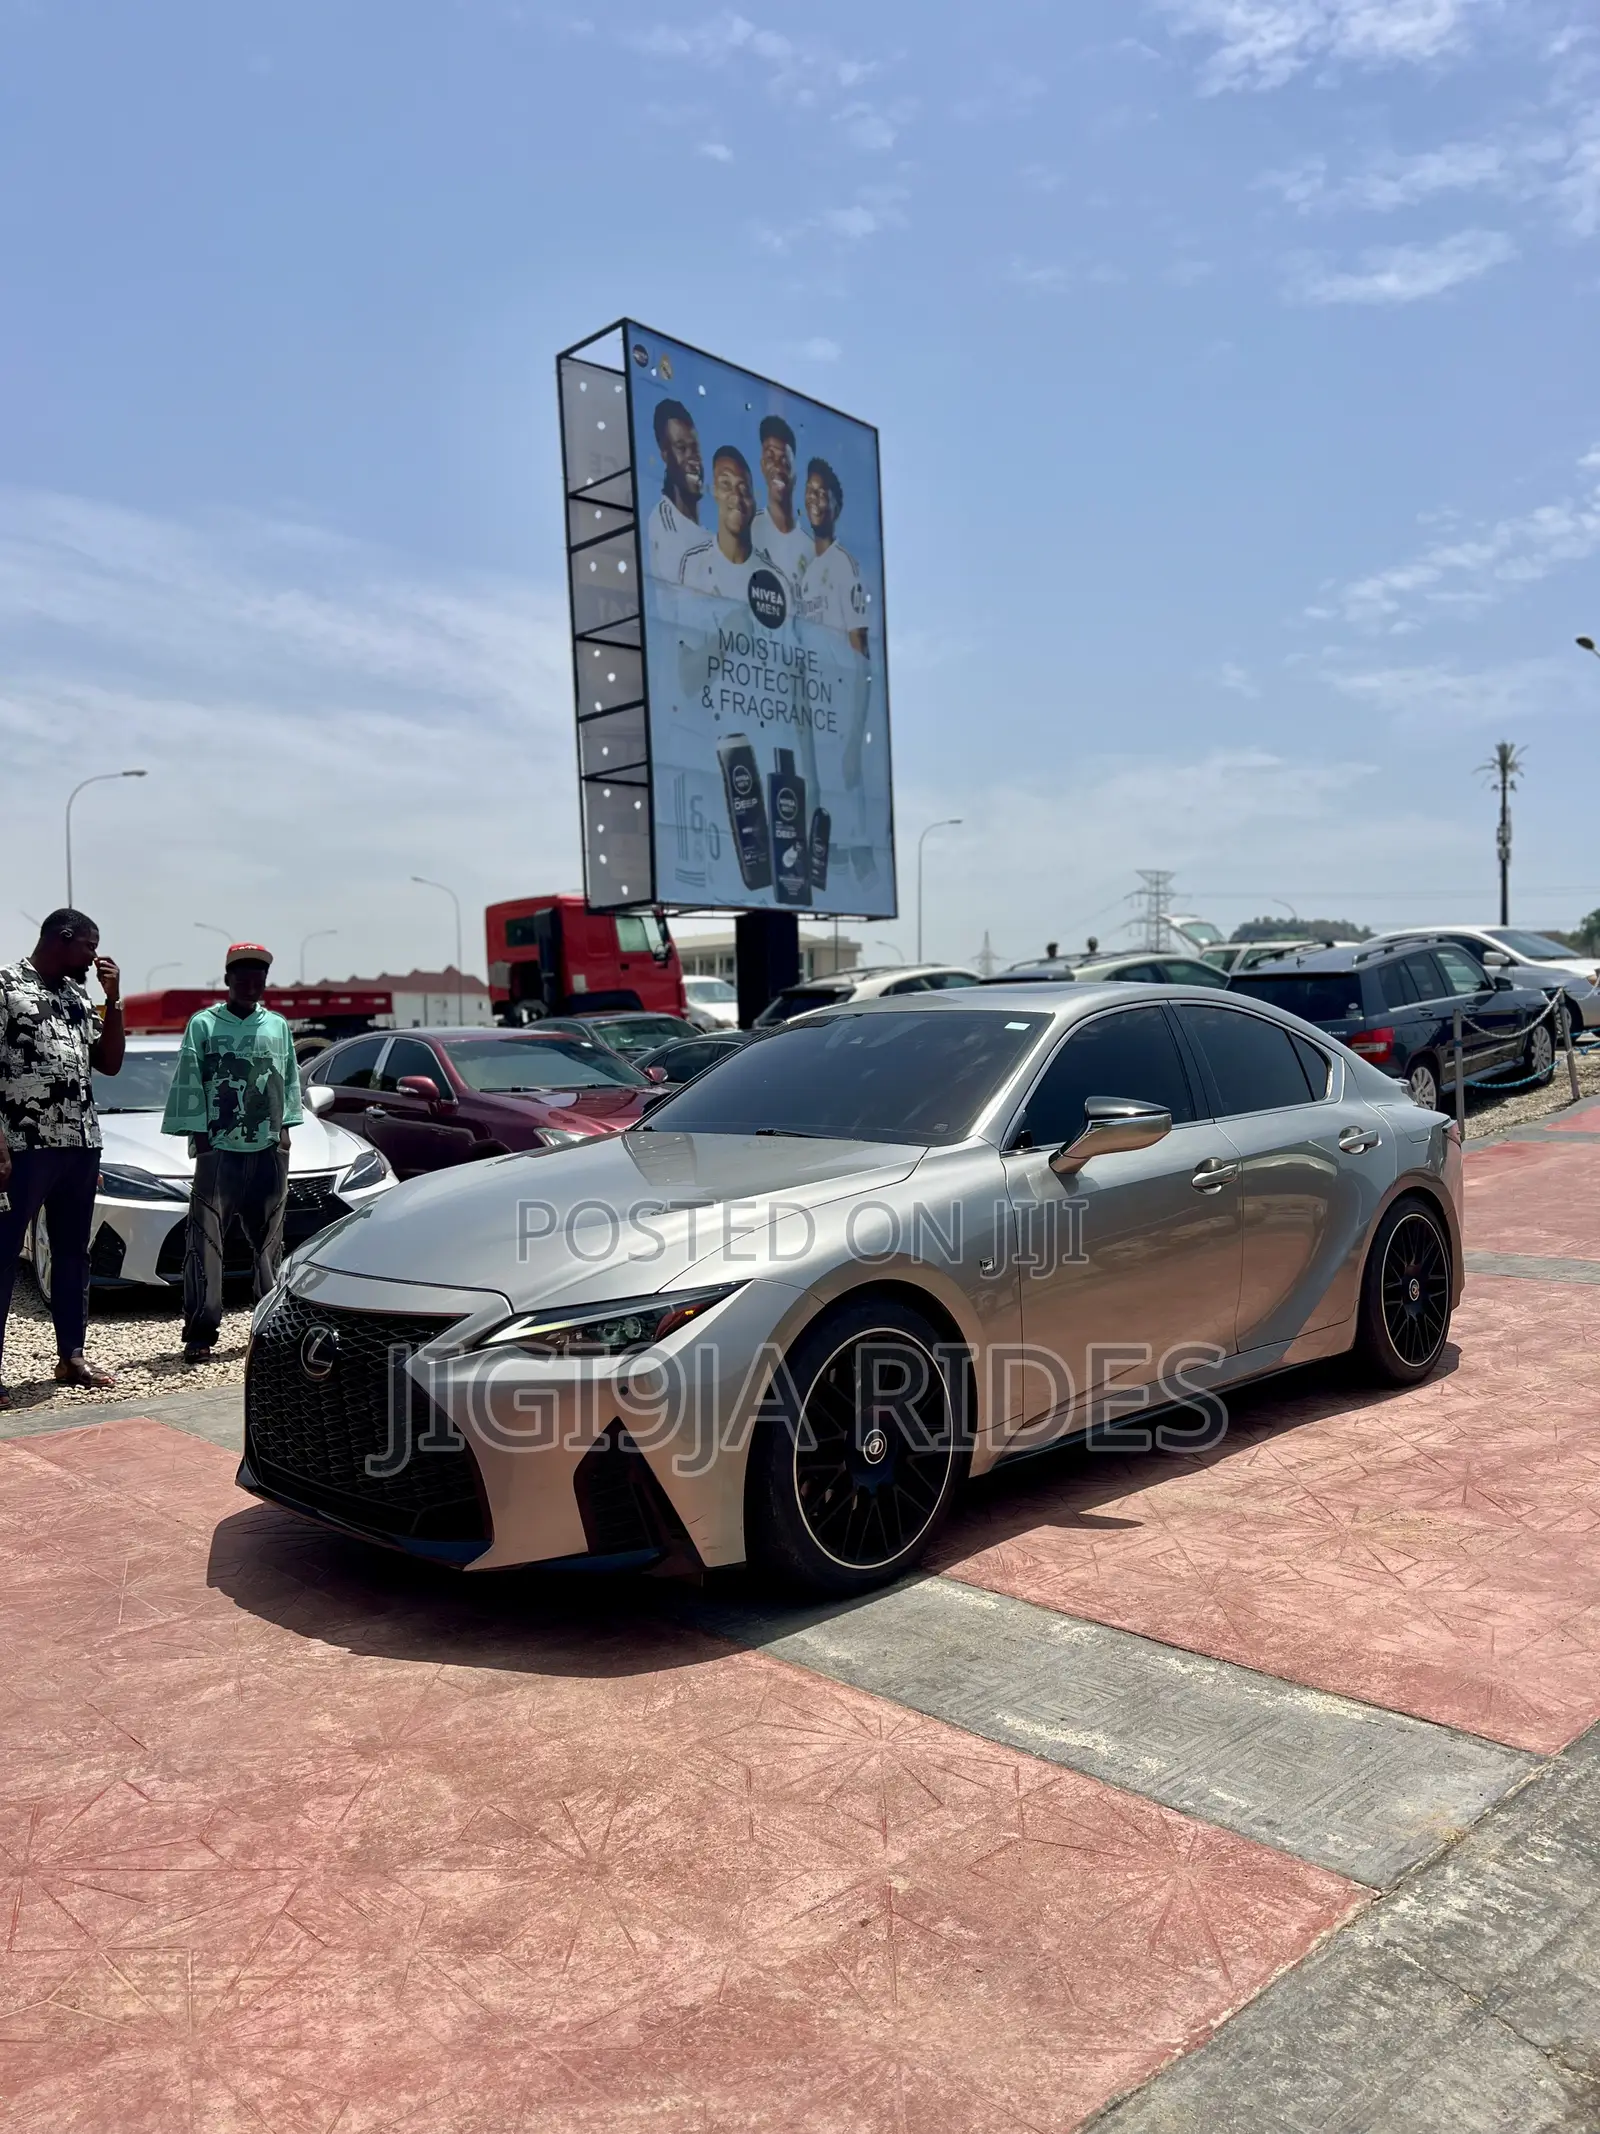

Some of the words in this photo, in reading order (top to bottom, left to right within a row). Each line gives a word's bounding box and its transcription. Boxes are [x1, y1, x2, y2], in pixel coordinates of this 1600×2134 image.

[751, 586, 784, 606] NIVEA
[756, 601, 780, 616] MEN
[719, 628, 823, 677] MOISTURE,
[707, 656, 832, 704] PROTECTION
[701, 685, 714, 709] &
[720, 689, 838, 733] FRAGRANCE
